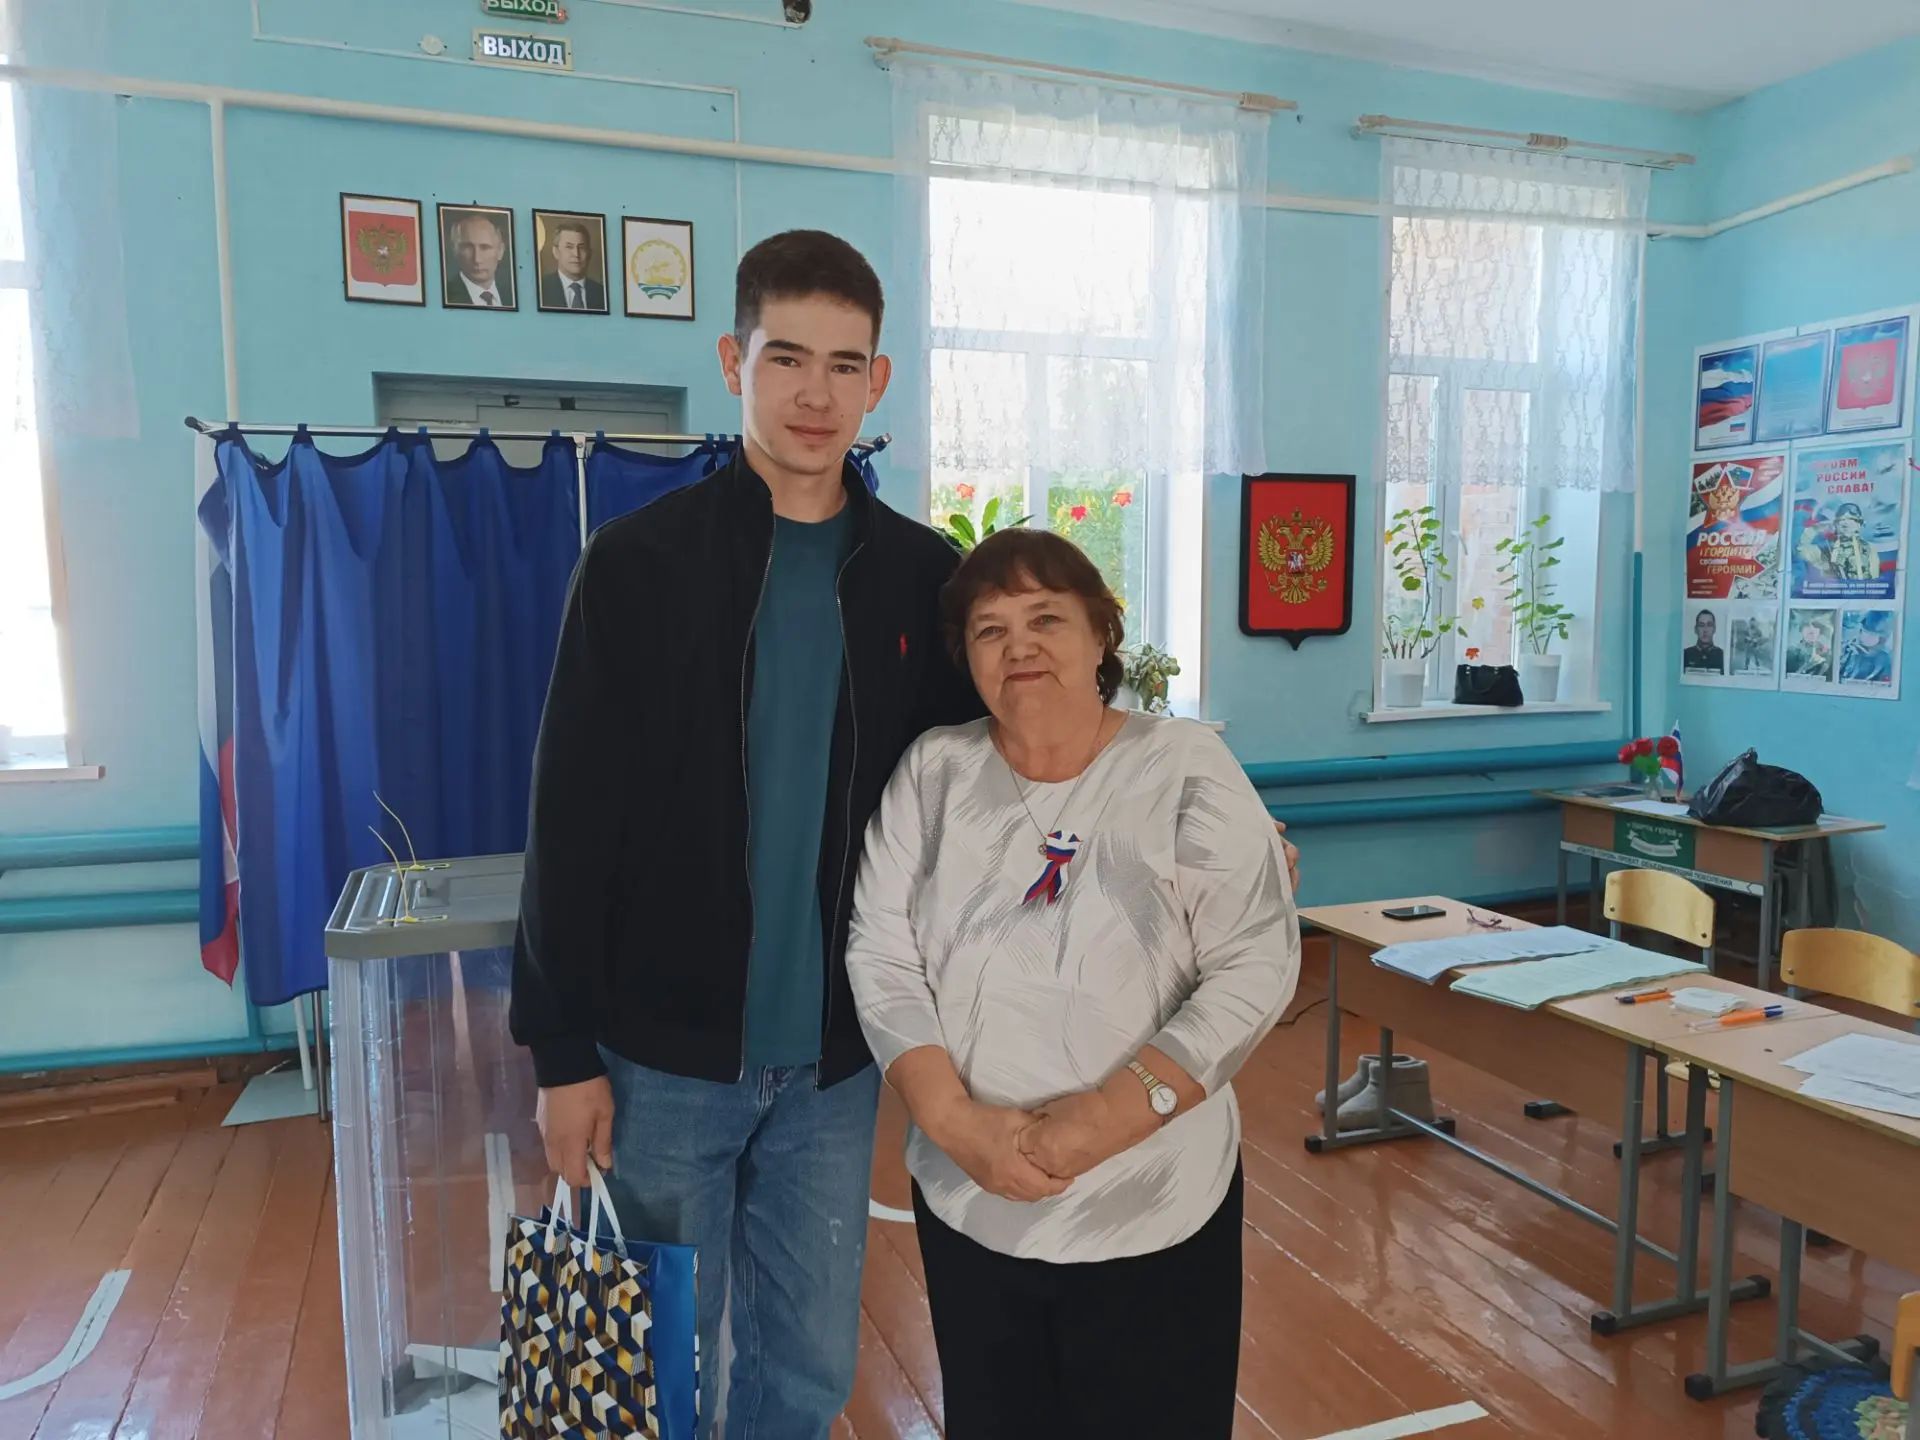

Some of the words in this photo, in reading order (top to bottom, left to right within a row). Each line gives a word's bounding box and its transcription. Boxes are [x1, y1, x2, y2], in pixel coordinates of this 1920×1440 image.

[483, 36, 564, 65] ВЫХОД
[1827, 482, 1874, 494] СЛАВА!
[1697, 530, 1768, 546] РОССИЯ
[1707, 564, 1756, 574] ГЕРОЯМИ!
